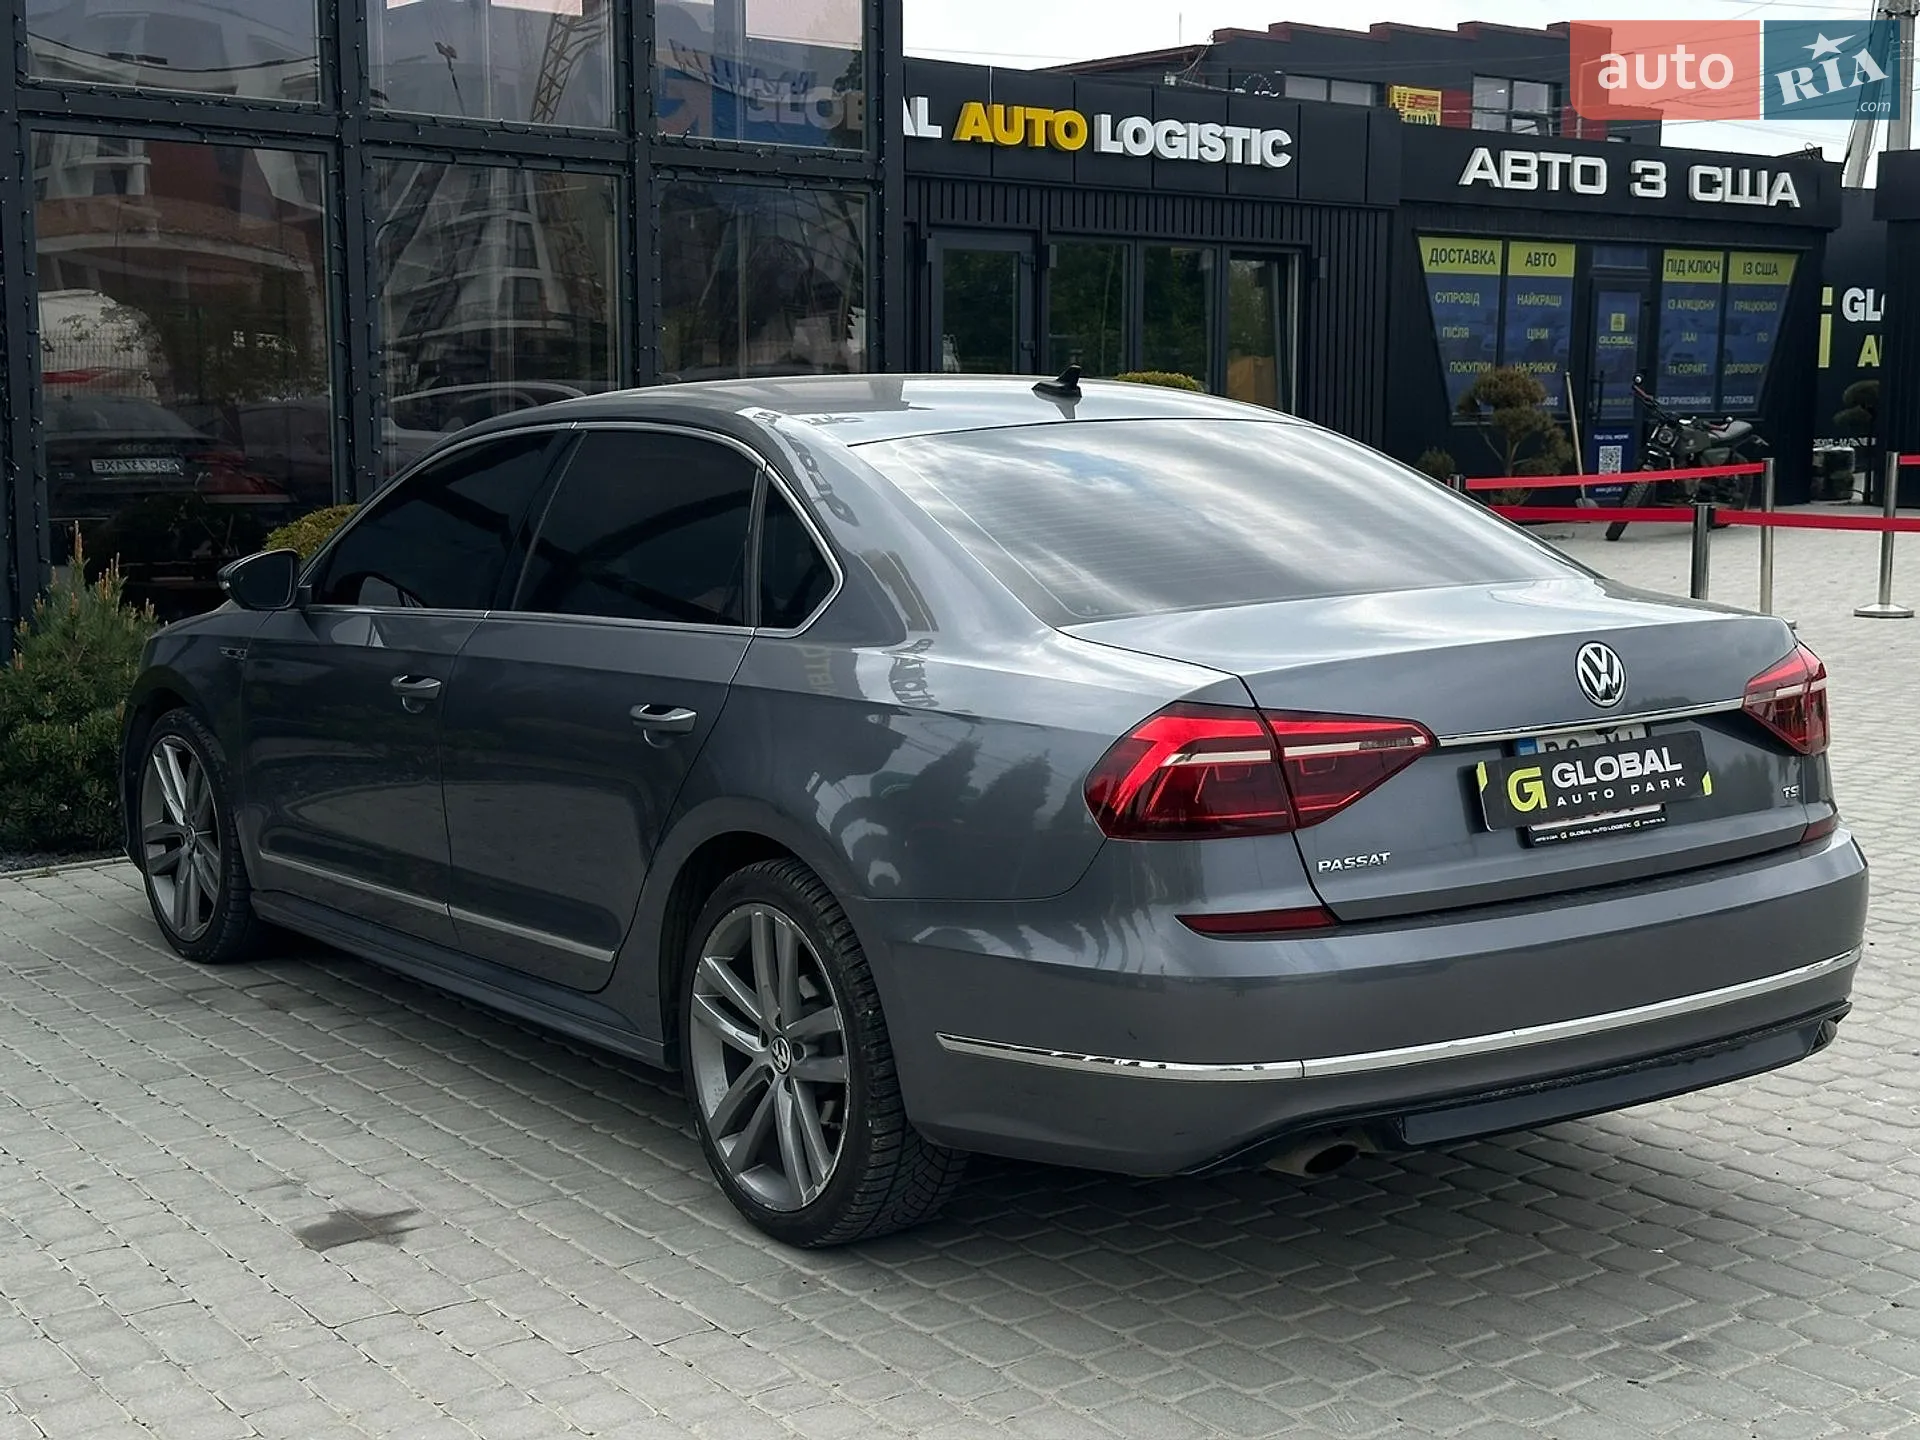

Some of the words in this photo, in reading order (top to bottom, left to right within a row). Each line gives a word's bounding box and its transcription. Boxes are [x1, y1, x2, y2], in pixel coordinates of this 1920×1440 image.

[953, 101, 1088, 151] AUTO
[1094, 113, 1292, 168] LOGISTIC
[1459, 147, 1608, 195] АВТО
[1689, 165, 1801, 208] США
[1428, 247, 1496, 267] ДОСТАВКА
[1525, 250, 1557, 268] АВТО
[1666, 257, 1689, 275] ПІД
[1690, 258, 1720, 275] КЛЮЧ
[1743, 262, 1754, 275] ІЗ
[1756, 263, 1779, 276] США
[1435, 292, 1480, 306] СУПРОВІД
[1517, 294, 1562, 308] НАЙКРАЩІ
[1842, 287, 1886, 322] GL
[1442, 327, 1470, 339] ПІСЛЯ
[1527, 328, 1549, 341] ЦІНИ
[1599, 336, 1635, 345] GLOBAL
[1552, 747, 1682, 788] GLOBAL
[1557, 788, 1614, 807] AUTO
[1630, 775, 1686, 795] PARK
[1317, 852, 1391, 873] PASSAT
